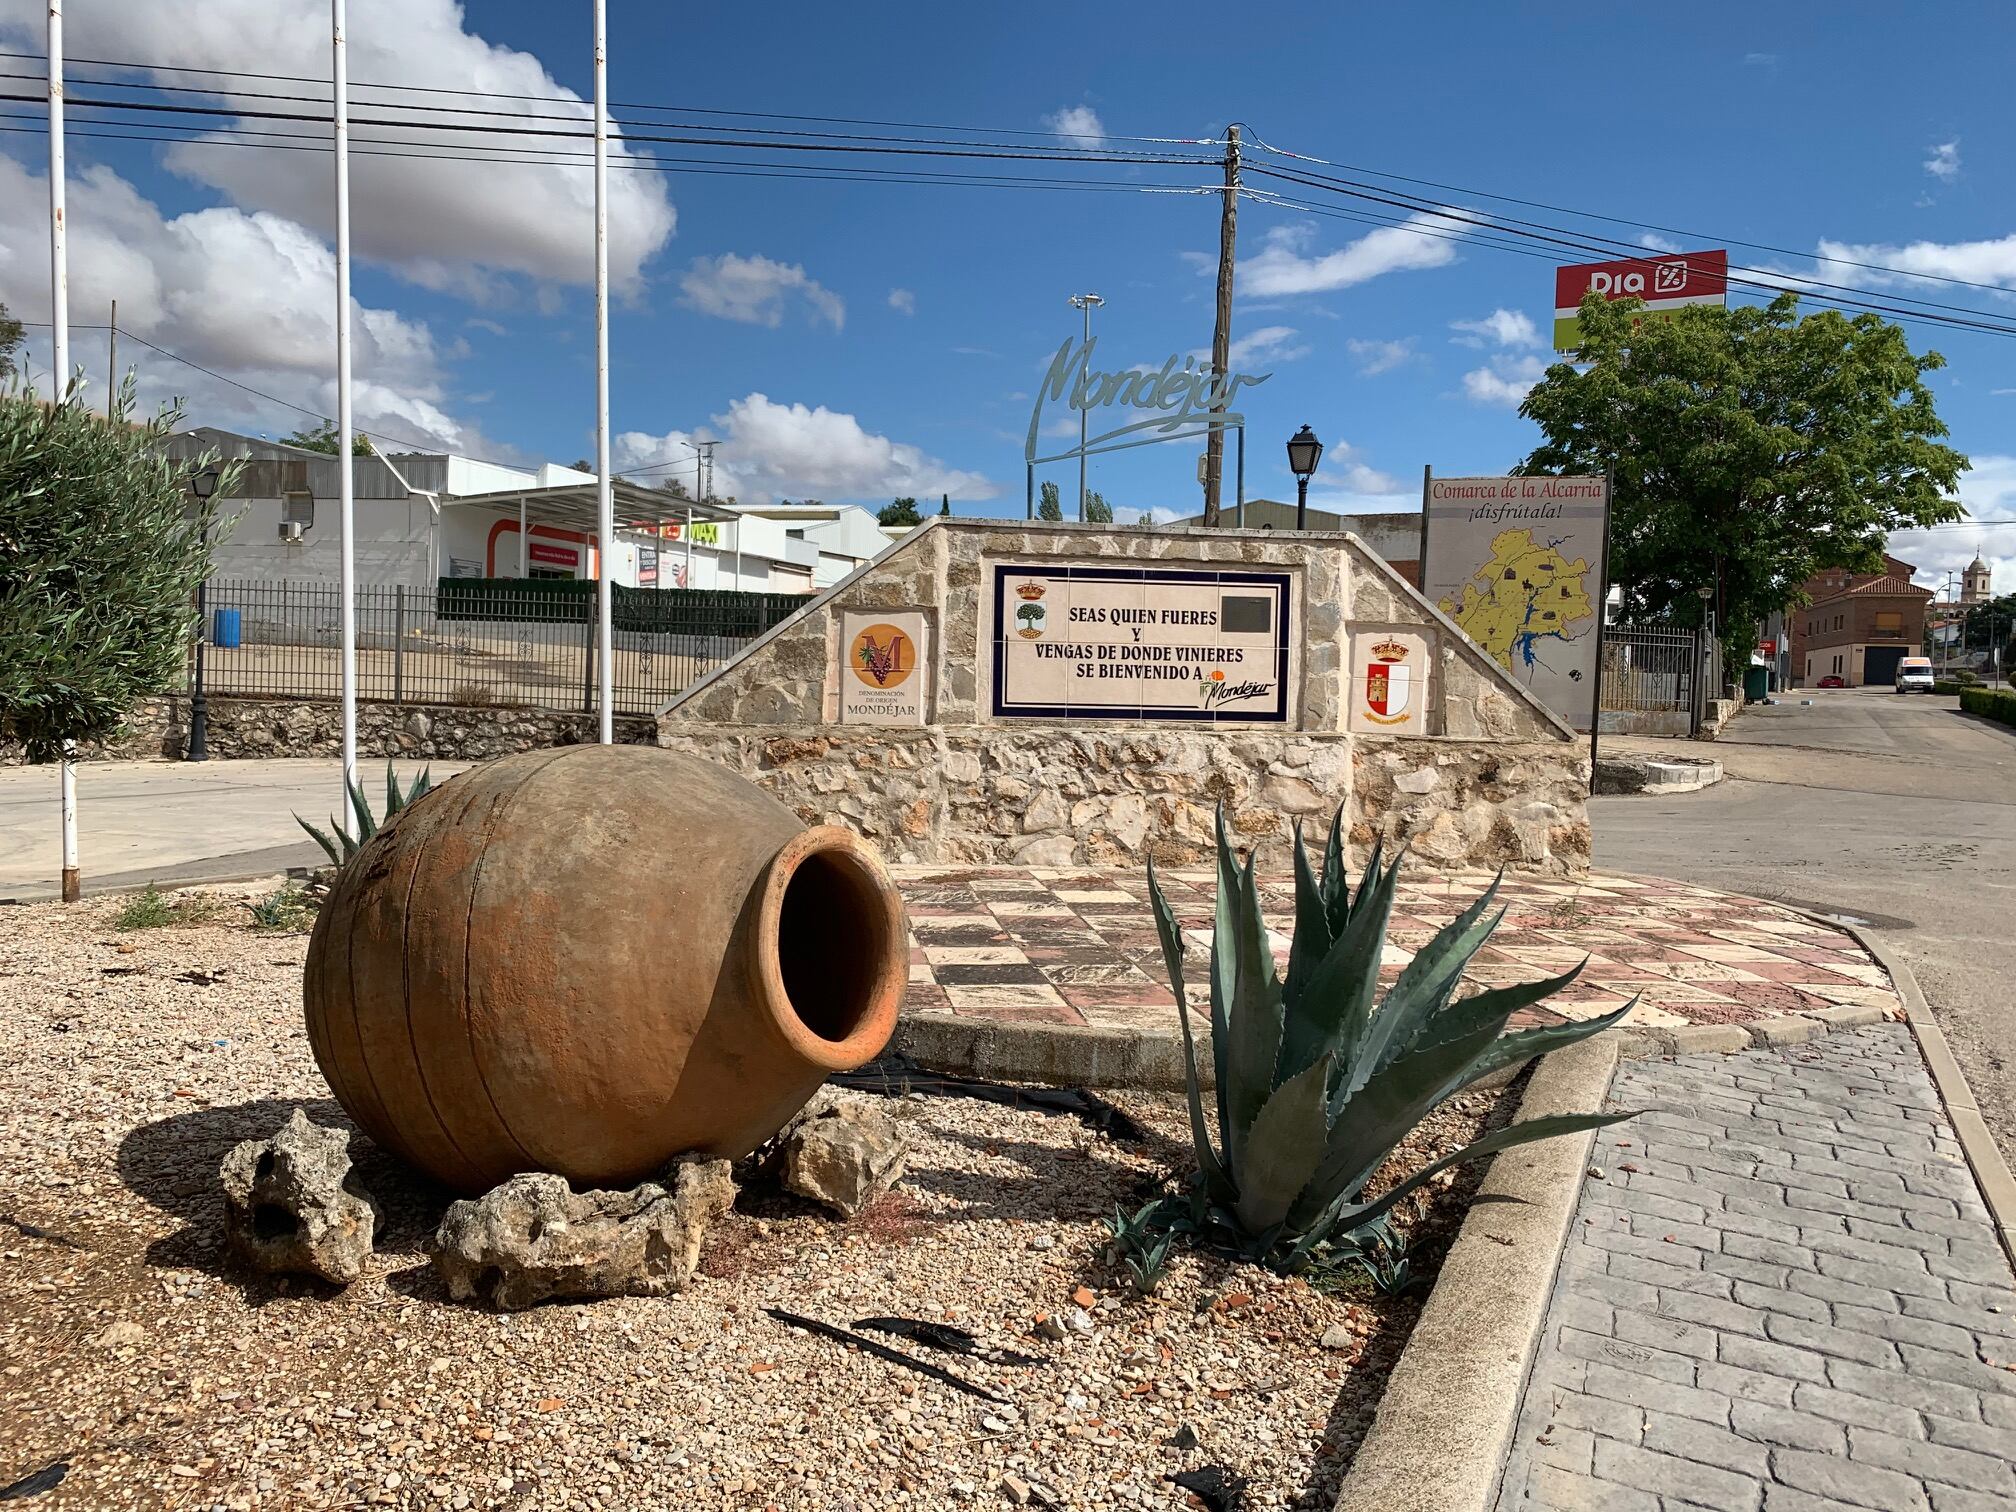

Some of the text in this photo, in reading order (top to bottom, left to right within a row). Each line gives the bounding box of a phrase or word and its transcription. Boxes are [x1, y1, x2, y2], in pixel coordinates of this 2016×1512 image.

[1025, 336, 1273, 460] Mondéjar
[1433, 479, 1603, 499] Comarca de la Alcarria
[1469, 502, 1563, 523] ¡disfrútala!
[1069, 607, 1217, 626] SEAS QUIEN FUERES
[1131, 627, 1141, 642] Y
[1035, 644, 1244, 662] VENGAS DE DONDE VINIERES
[1076, 663, 1203, 680] SE BIENVENIDO A
[1205, 680, 1277, 709] Mondéjar
[847, 703, 916, 717] MONDÉJAR
